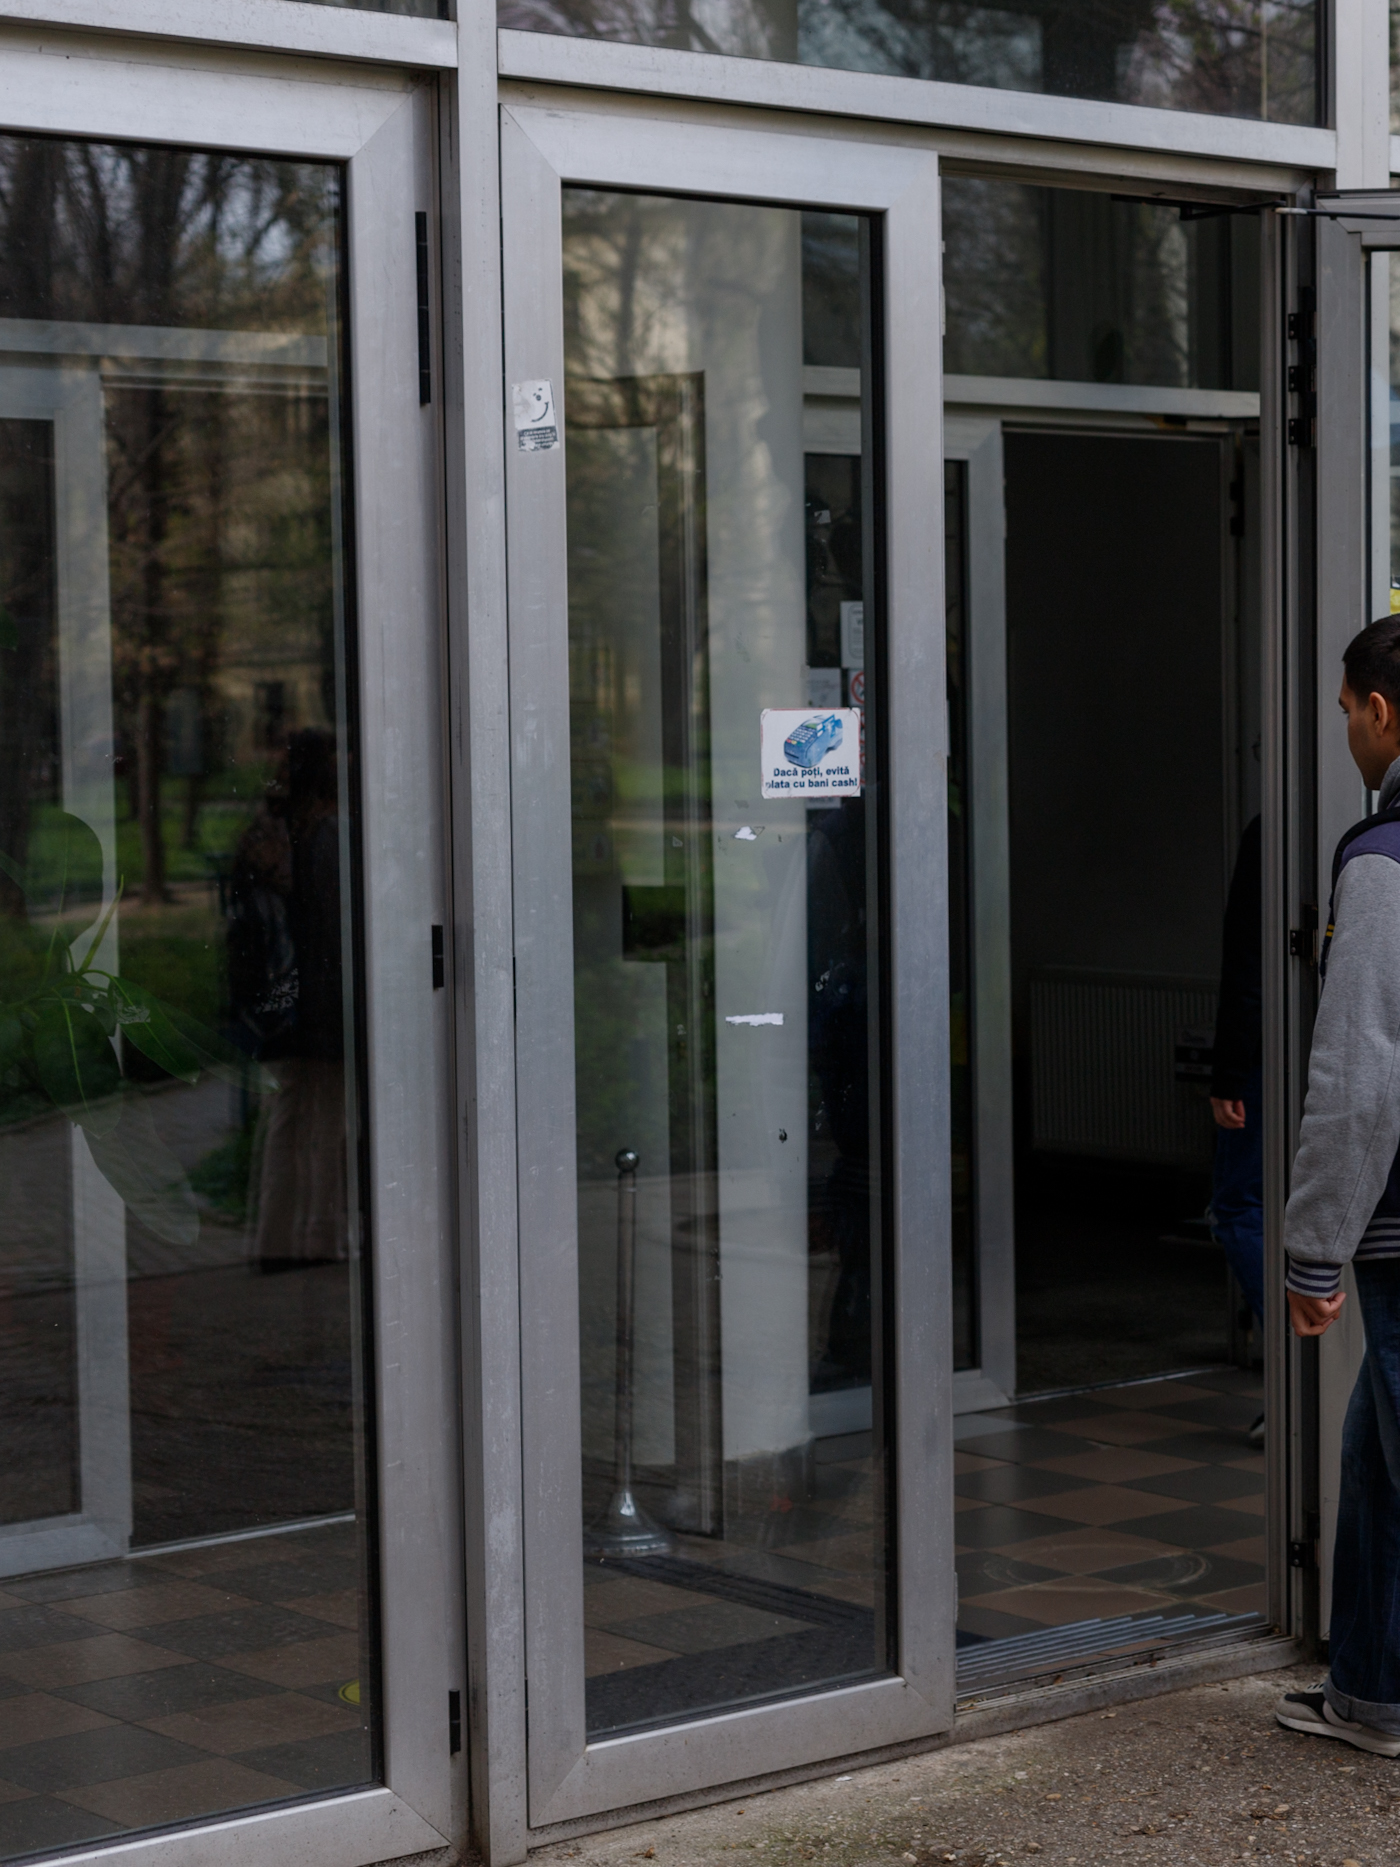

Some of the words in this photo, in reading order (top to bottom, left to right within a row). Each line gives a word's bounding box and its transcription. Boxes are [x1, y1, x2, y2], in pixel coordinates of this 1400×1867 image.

[773, 767, 798, 777] Dacă
[826, 766, 850, 776] evită
[808, 779, 829, 788] bani
[831, 778, 858, 788] cash!
